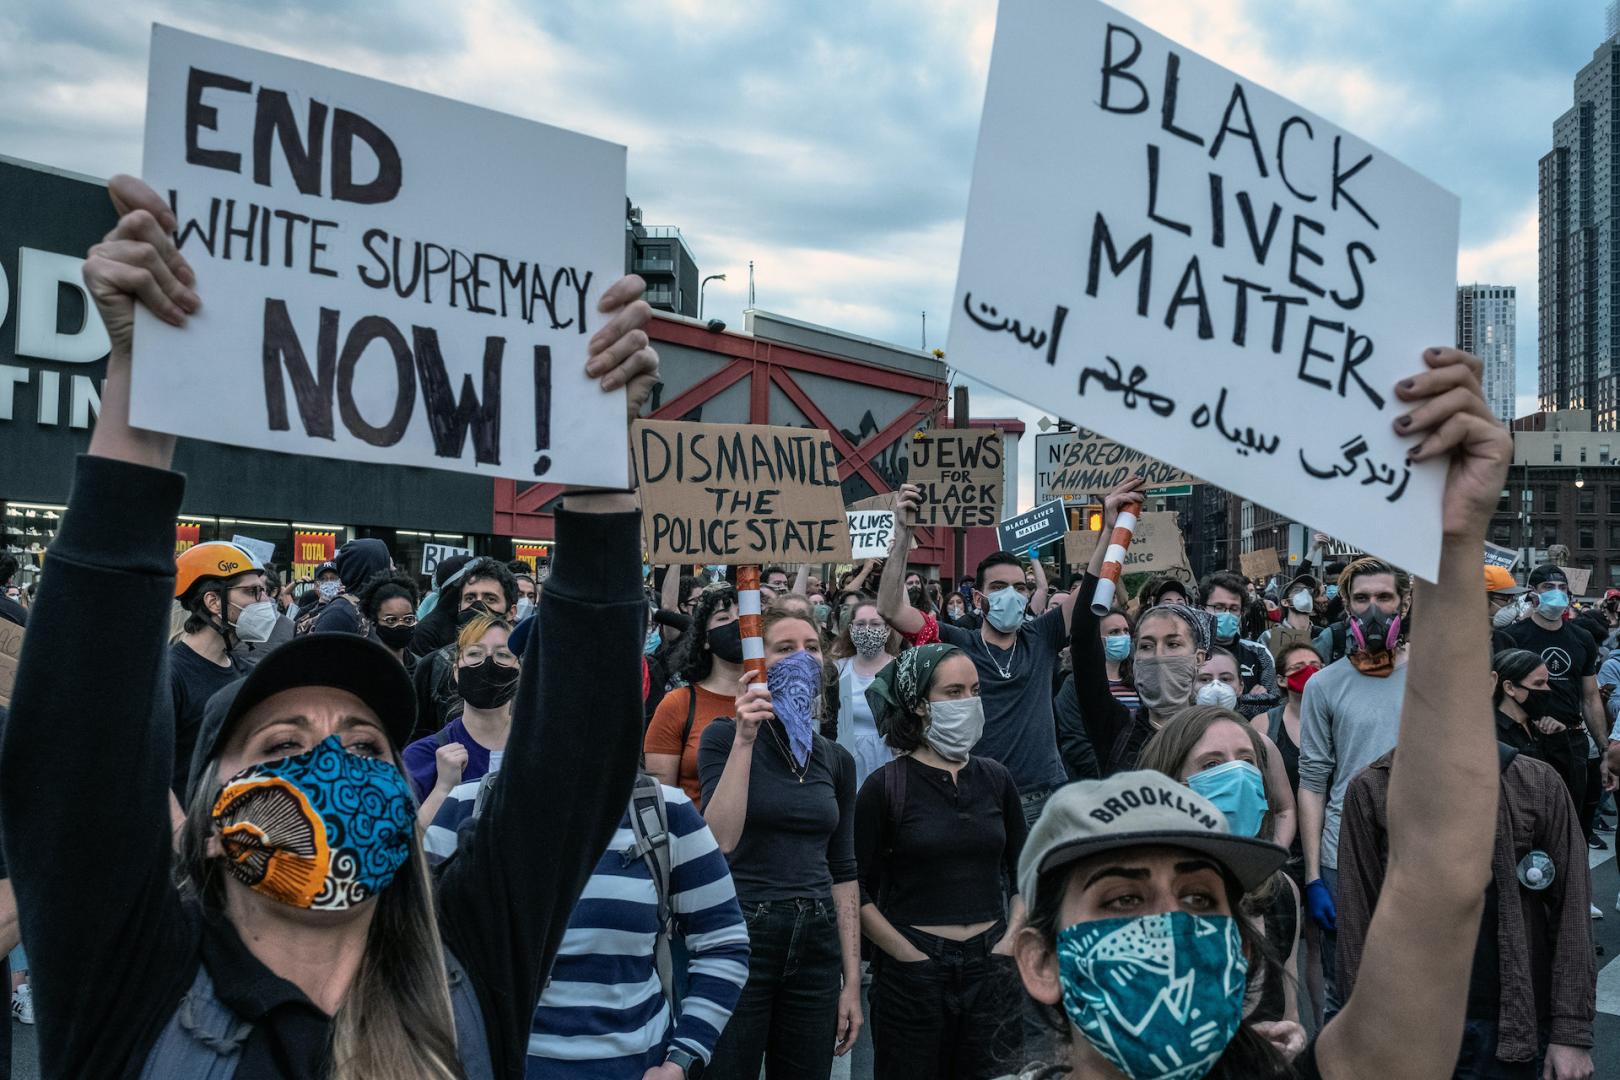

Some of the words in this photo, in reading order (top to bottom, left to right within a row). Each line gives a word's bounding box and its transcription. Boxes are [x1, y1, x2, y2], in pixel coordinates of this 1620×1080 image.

[185, 65, 402, 205] END
[1094, 22, 1379, 230] BLACK
[1146, 143, 1376, 310] LIVES
[168, 189, 339, 278] WHITE
[357, 227, 594, 334] SUPREMACY
[0, 246, 112, 363] D
[1085, 211, 1385, 410] MATTER
[262, 297, 552, 476] NOW!
[641, 427, 840, 487] DISMANTLE
[912, 436, 1001, 469] JEWS
[1049, 443, 1070, 464] N
[1063, 442, 1155, 468] BREONN
[940, 470, 973, 483] FOR
[1051, 466, 1130, 491] AHMAUD
[704, 486, 780, 515] THE
[914, 505, 996, 527] LIVES
[652, 513, 741, 556] POLICE
[746, 518, 843, 555] STATE
[859, 514, 894, 529] LIVES
[1004, 517, 1029, 532] BLACK
[1033, 507, 1055, 520] LIVES
[1018, 520, 1048, 537] MATTER
[217, 560, 239, 573] Giro
[301, 543, 326, 560] TOTAL
[1089, 786, 1218, 829] BROOKLYN
